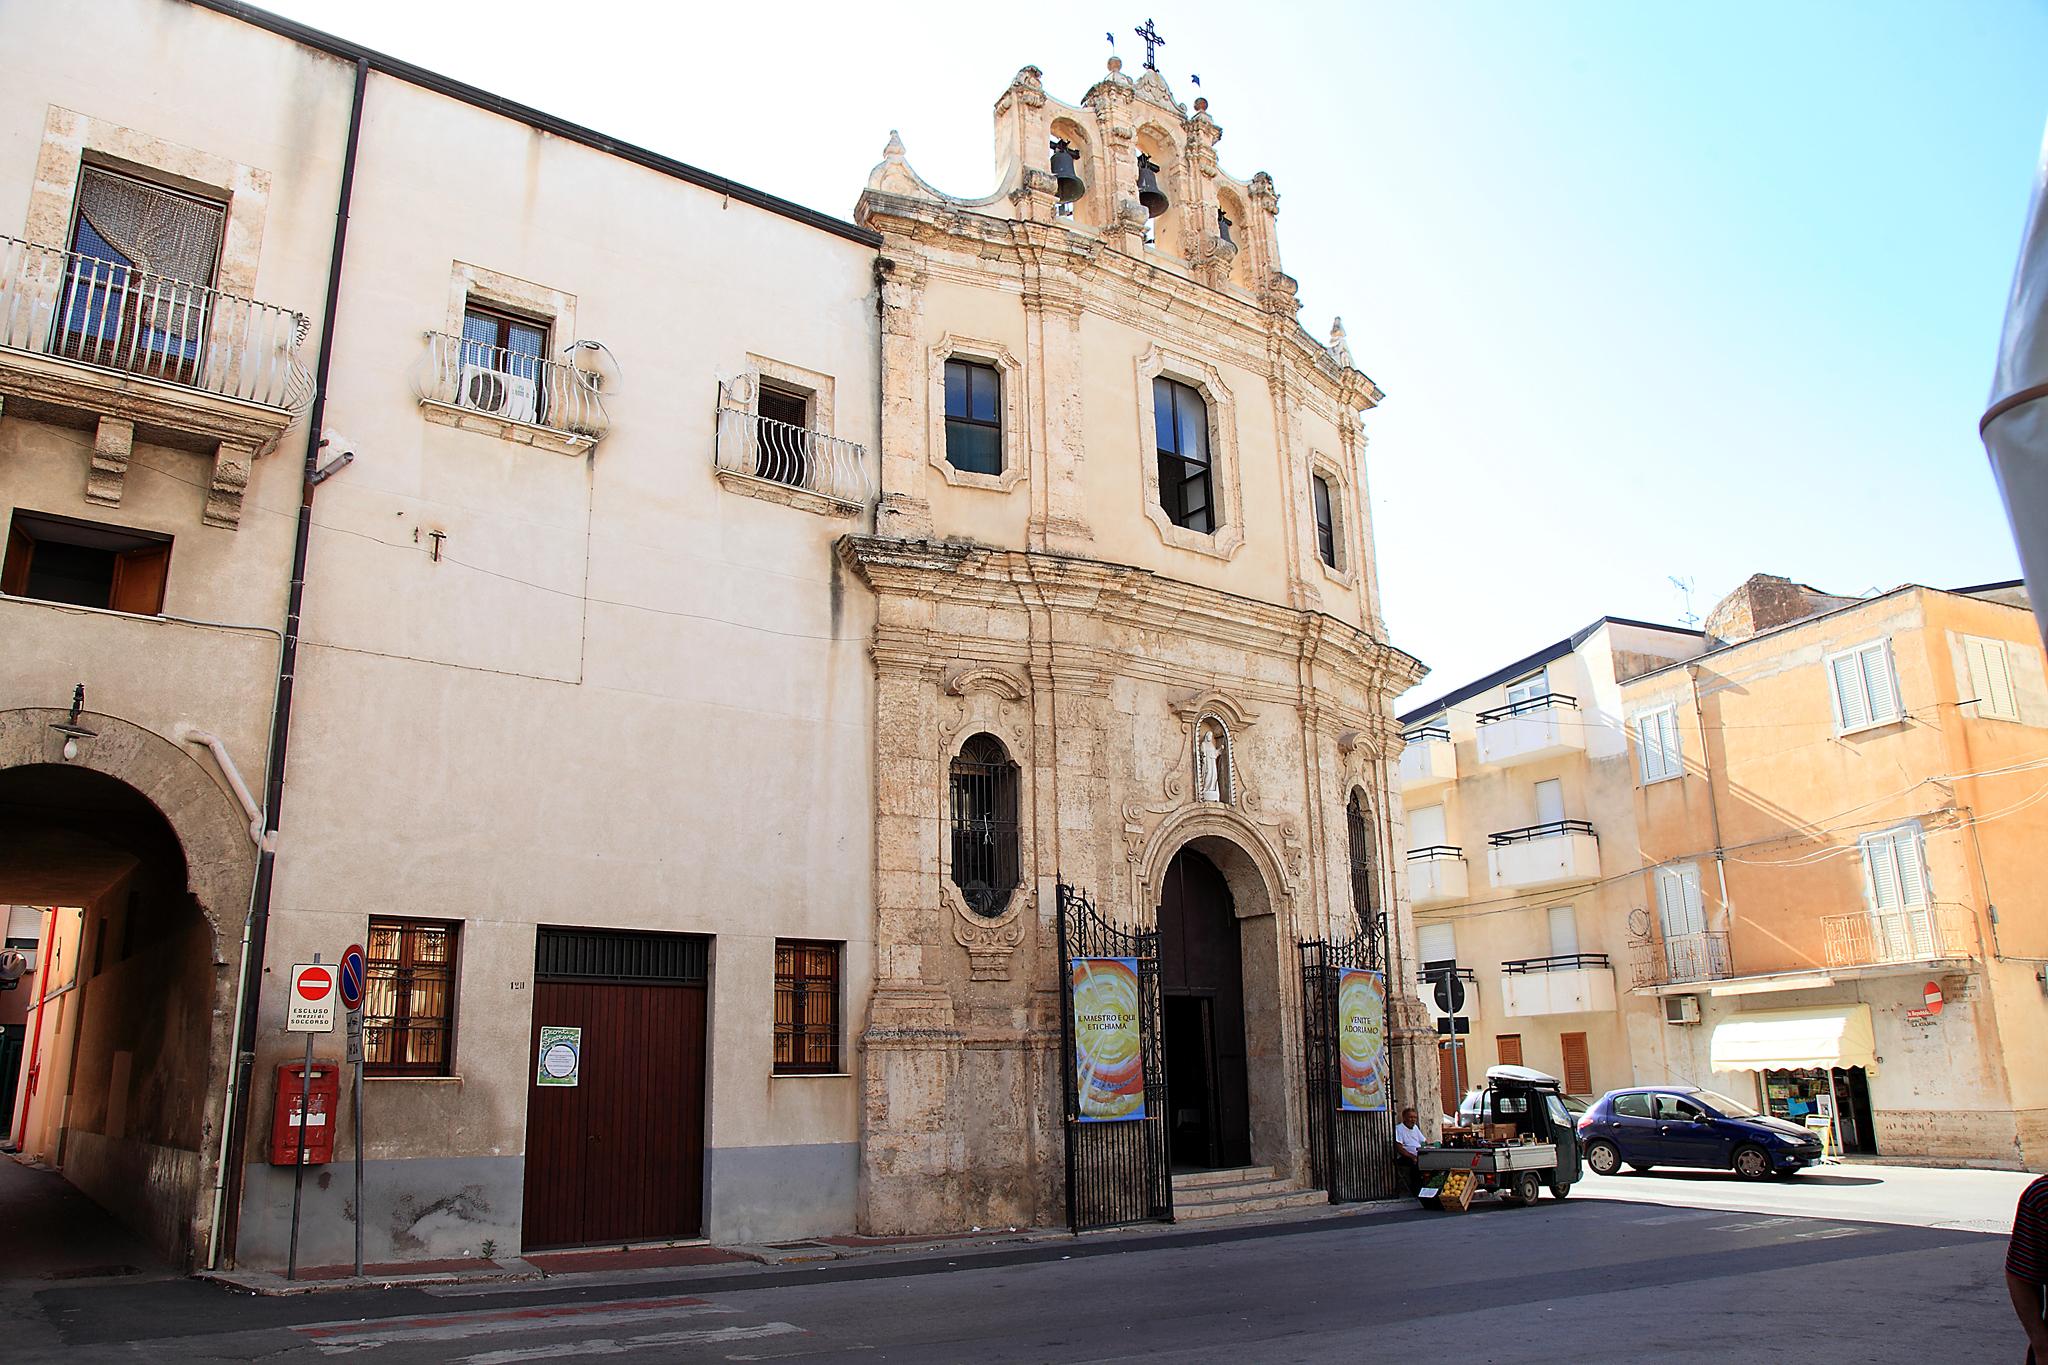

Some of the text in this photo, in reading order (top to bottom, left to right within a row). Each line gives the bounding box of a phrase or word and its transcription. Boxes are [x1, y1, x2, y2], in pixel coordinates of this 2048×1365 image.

[1122, 1014, 1136, 1022] QUI
[1350, 1016, 1371, 1024] VENITE
[1344, 1025, 1379, 1034] ADORIAMO
